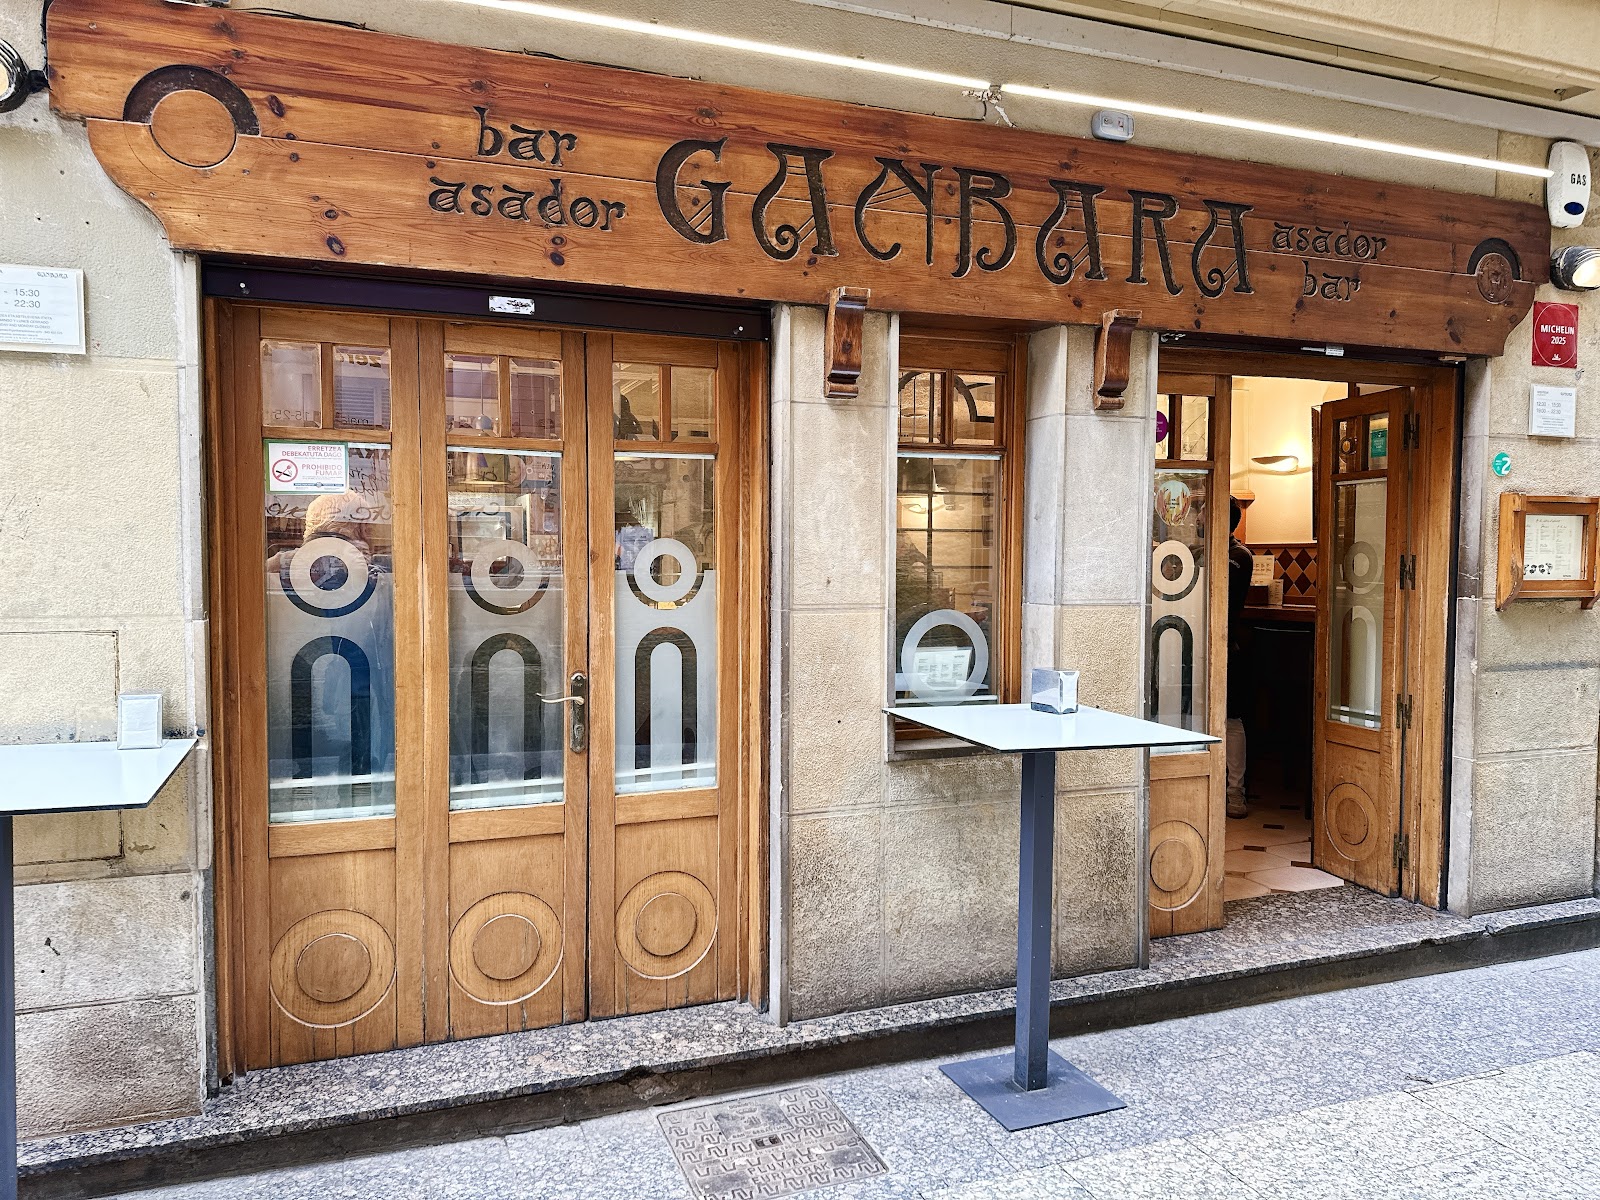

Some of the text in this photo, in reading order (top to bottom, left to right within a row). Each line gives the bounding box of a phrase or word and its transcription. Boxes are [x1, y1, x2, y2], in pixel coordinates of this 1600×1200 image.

[473, 106, 578, 166] bar
[1570, 173, 1587, 186] GAS
[428, 176, 626, 232] asador
[656, 137, 1254, 299] GANBARA
[1272, 221, 1388, 260] asador
[1302, 260, 1361, 302] bar
[14, 288, 40, 297] 15:30
[14, 299, 41, 308] 22:30
[1540, 324, 1575, 335] MICHELIN
[1550, 336, 1567, 345] 2025
[301, 463, 343, 471] PROHIBIDO
[1501, 456, 1511, 475] 2
[747, 1153, 825, 1175] PLUVIALES
[752, 1162, 831, 1185] EURI URAK
